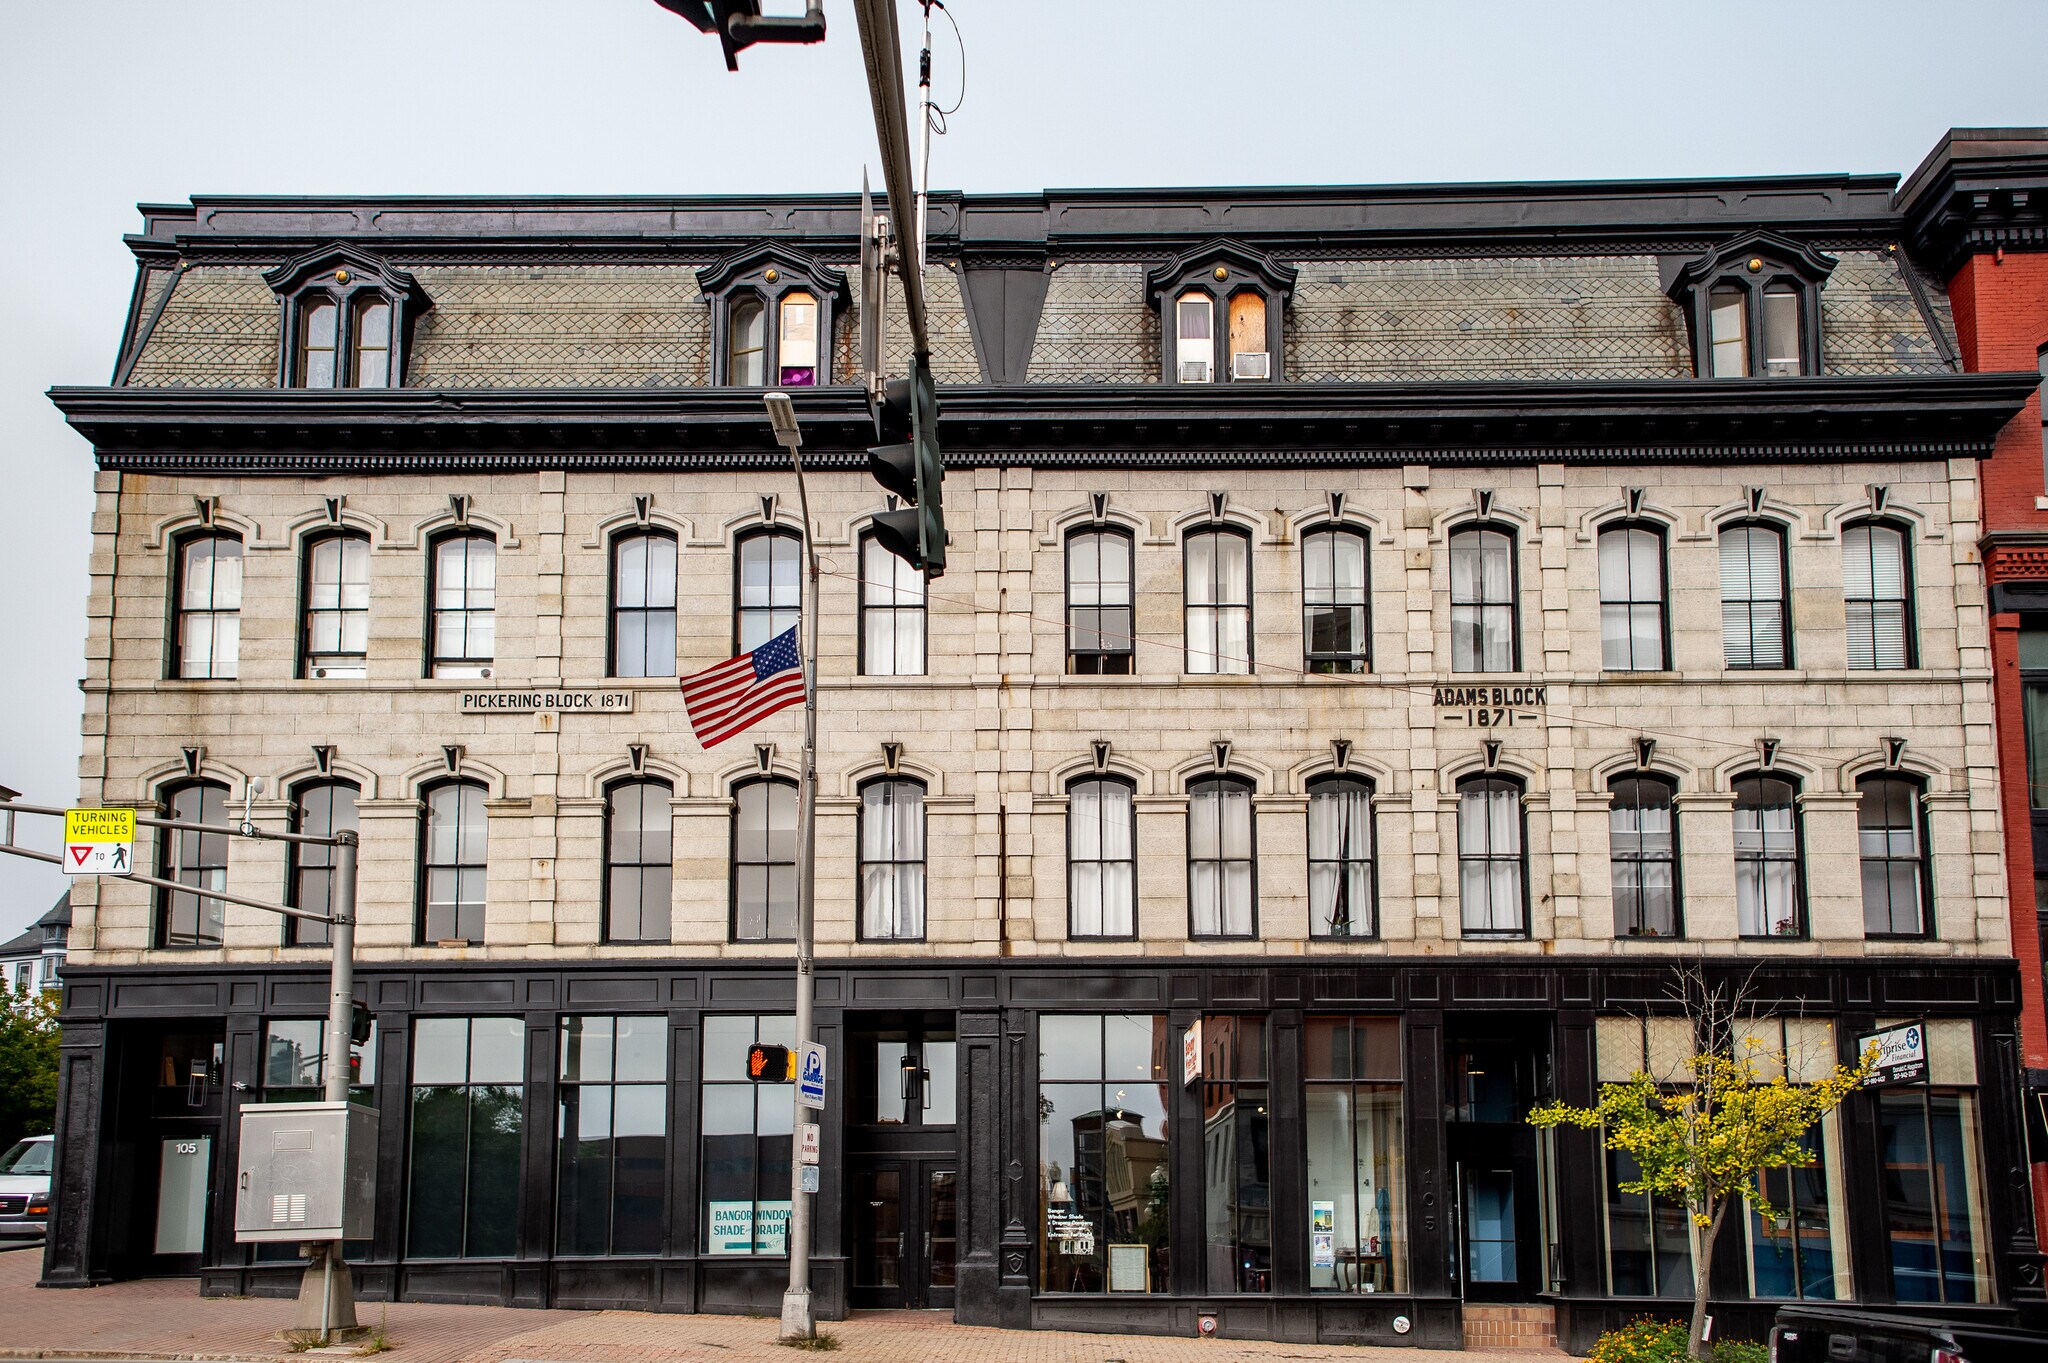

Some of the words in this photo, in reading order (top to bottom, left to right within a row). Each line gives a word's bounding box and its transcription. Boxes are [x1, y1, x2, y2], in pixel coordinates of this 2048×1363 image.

[464, 694, 541, 708] PICKERING
[545, 694, 593, 708] BLOCK
[601, 694, 628, 707] 1871
[1432, 688, 1488, 706] ADAMS
[1492, 688, 1546, 706] BLOCK
[1468, 709, 1513, 727] 1871
[75, 812, 127, 823] TURNING
[72, 825, 128, 835] VEHICLES
[95, 852, 105, 861] TO
[1891, 1050, 1916, 1062] Financial
[803, 1070, 823, 1085] GARAGE
[806, 1133, 814, 1142] NO
[176, 1143, 196, 1153] 105
[802, 1145, 818, 1154] PARKING
[715, 1210, 752, 1221] BANGOR
[714, 1225, 746, 1235] SHADE
[756, 1224, 786, 1235] DRAPE
